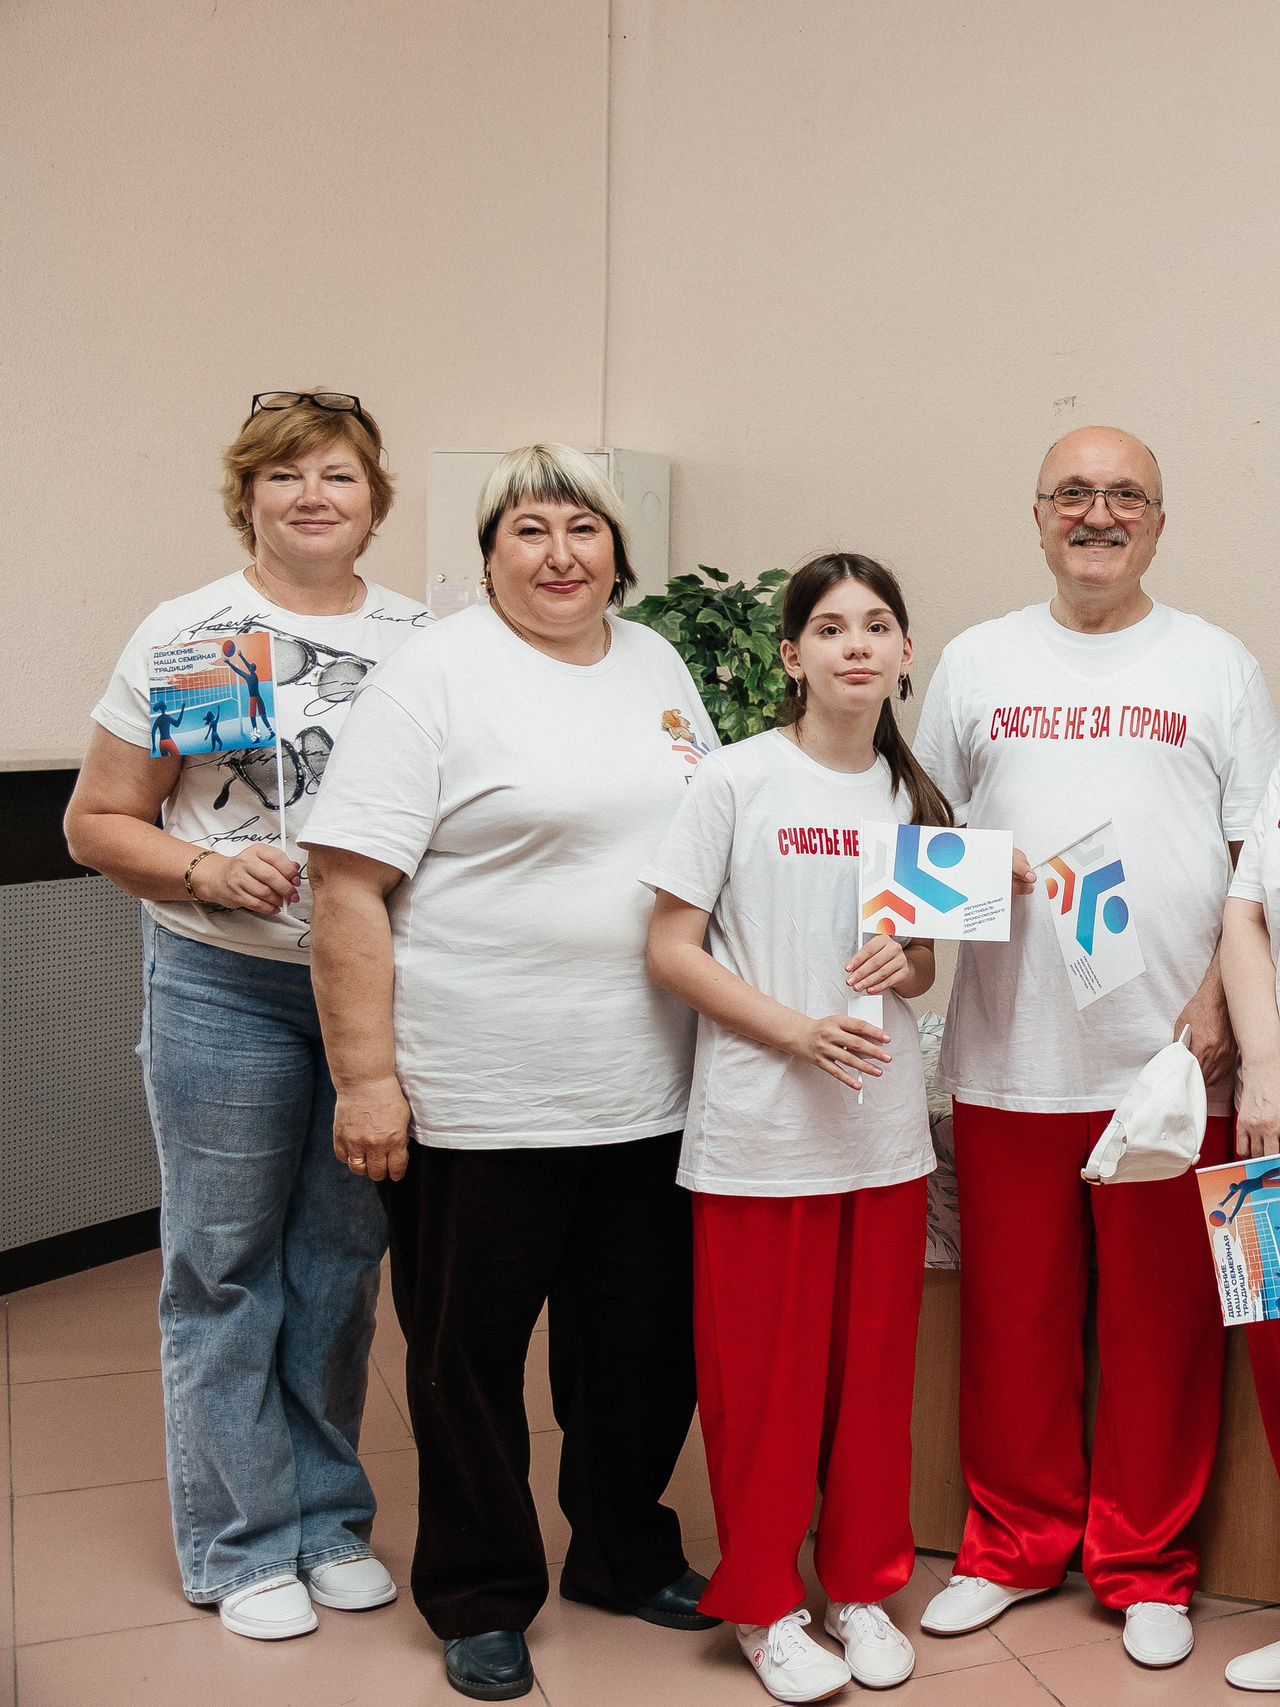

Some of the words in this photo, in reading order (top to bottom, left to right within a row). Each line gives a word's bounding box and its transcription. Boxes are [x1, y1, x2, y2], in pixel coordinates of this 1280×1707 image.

[153, 648, 194, 658] ДВИЖЕНИЕ
[153, 657, 176, 666] НАША
[178, 653, 216, 663] СЕМЕЙНАЯ
[154, 664, 194, 674] ТРАДИЦИЯ
[990, 706, 1062, 741] СЧАСТЬЕ
[1064, 707, 1087, 740] НЕ
[1090, 706, 1110, 738] ЗА
[1119, 706, 1187, 748] ГОРАМИ
[777, 827, 840, 856] СЧАСТЬЕ
[842, 829, 859, 857] НЕ
[1223, 1235, 1237, 1286] СЕМЕЙНАЯ
[1221, 1265, 1235, 1318] ДВИЖЕНИЕ
[1233, 1288, 1242, 1317] НАША
[1237, 1265, 1249, 1316] ТРАДИЦИЯ
